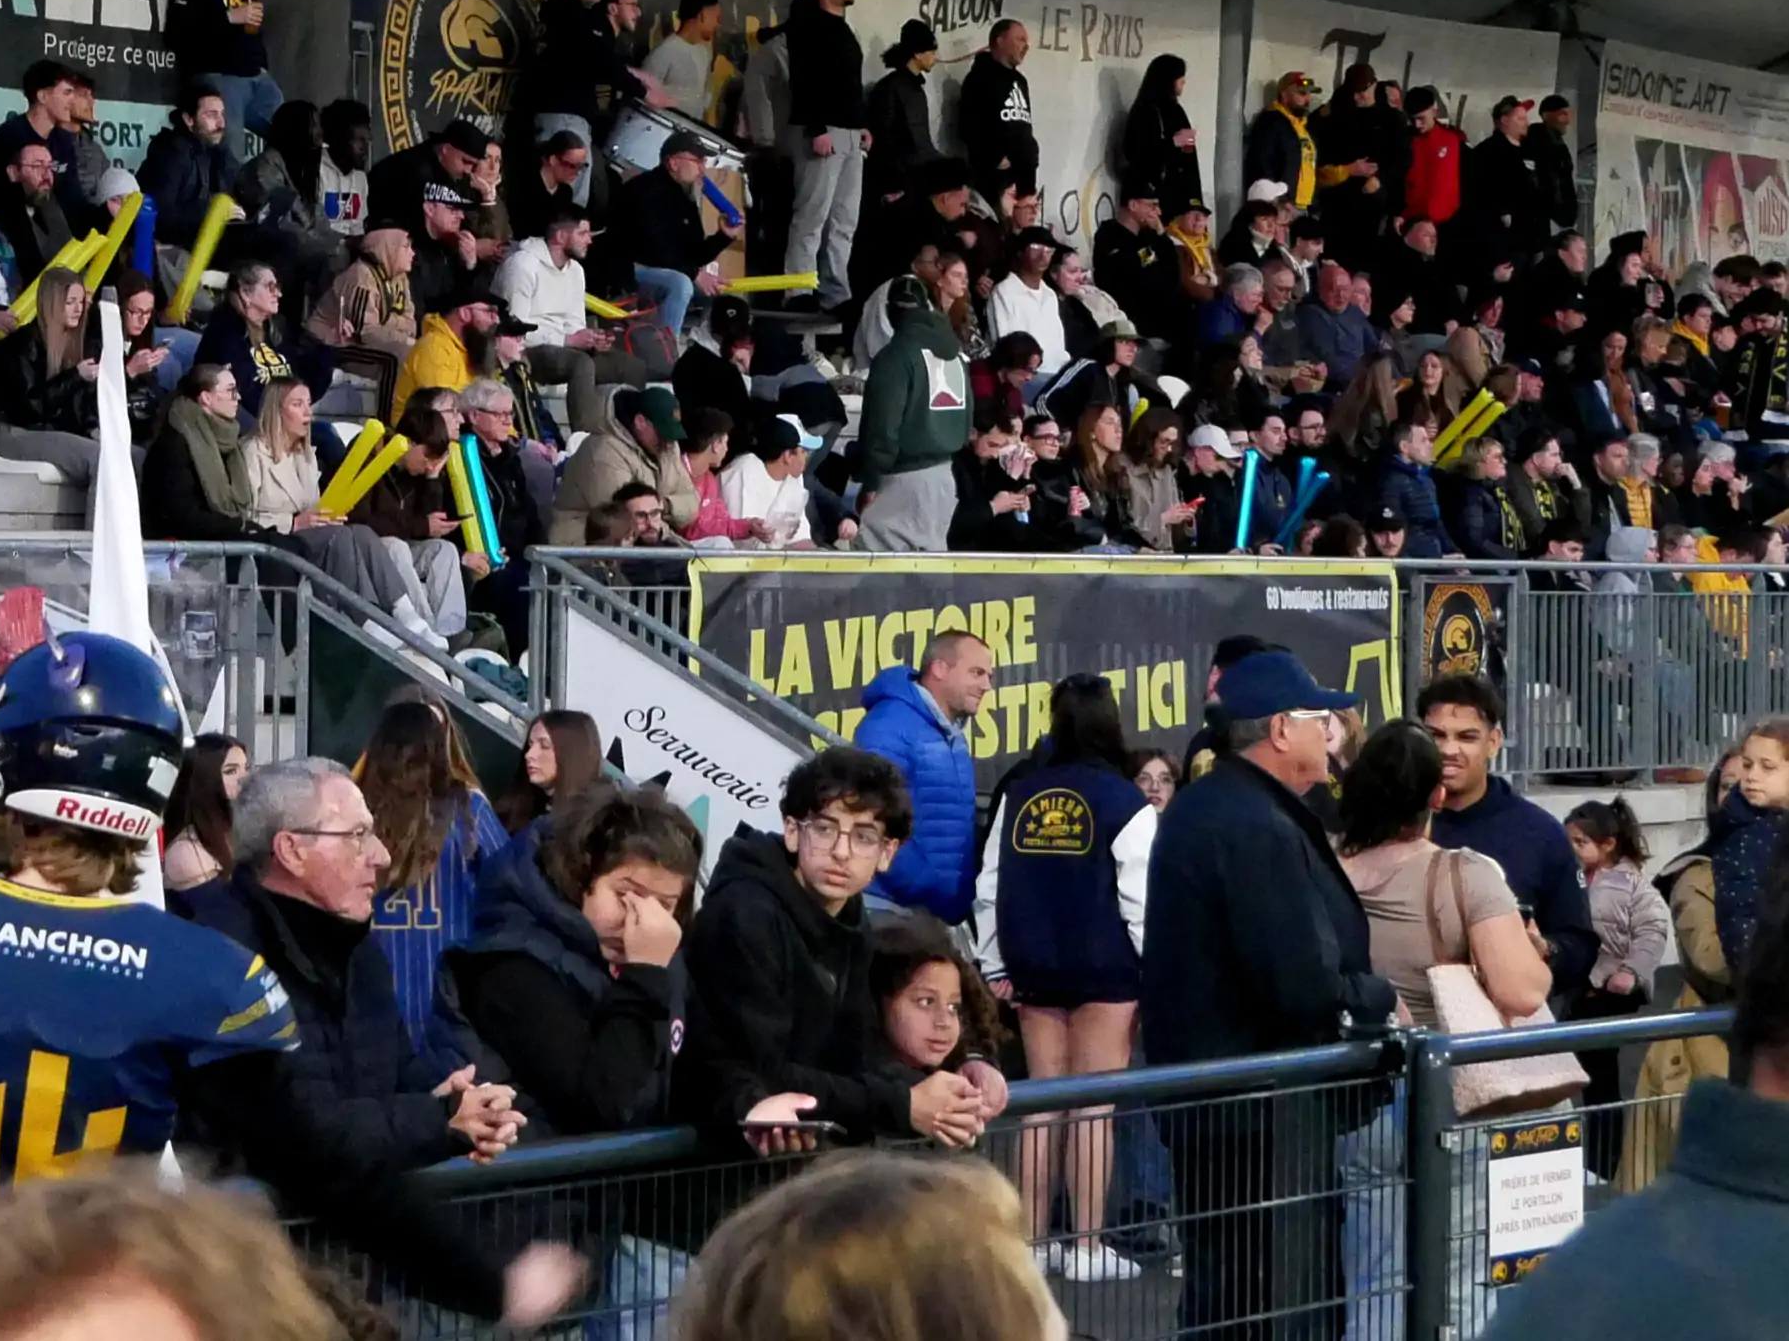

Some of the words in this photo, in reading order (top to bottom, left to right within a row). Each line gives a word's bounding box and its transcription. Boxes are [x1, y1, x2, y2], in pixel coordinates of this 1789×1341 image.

[1037, 6, 1071, 52] LE
[123, 47, 143, 65] ce
[146, 49, 176, 72] que
[747, 624, 814, 701] LA
[1136, 660, 1187, 732] ICI
[624, 706, 770, 809] Serrurerie
[56, 797, 151, 836] Riddell
[49, 955, 144, 980] FROMAGER
